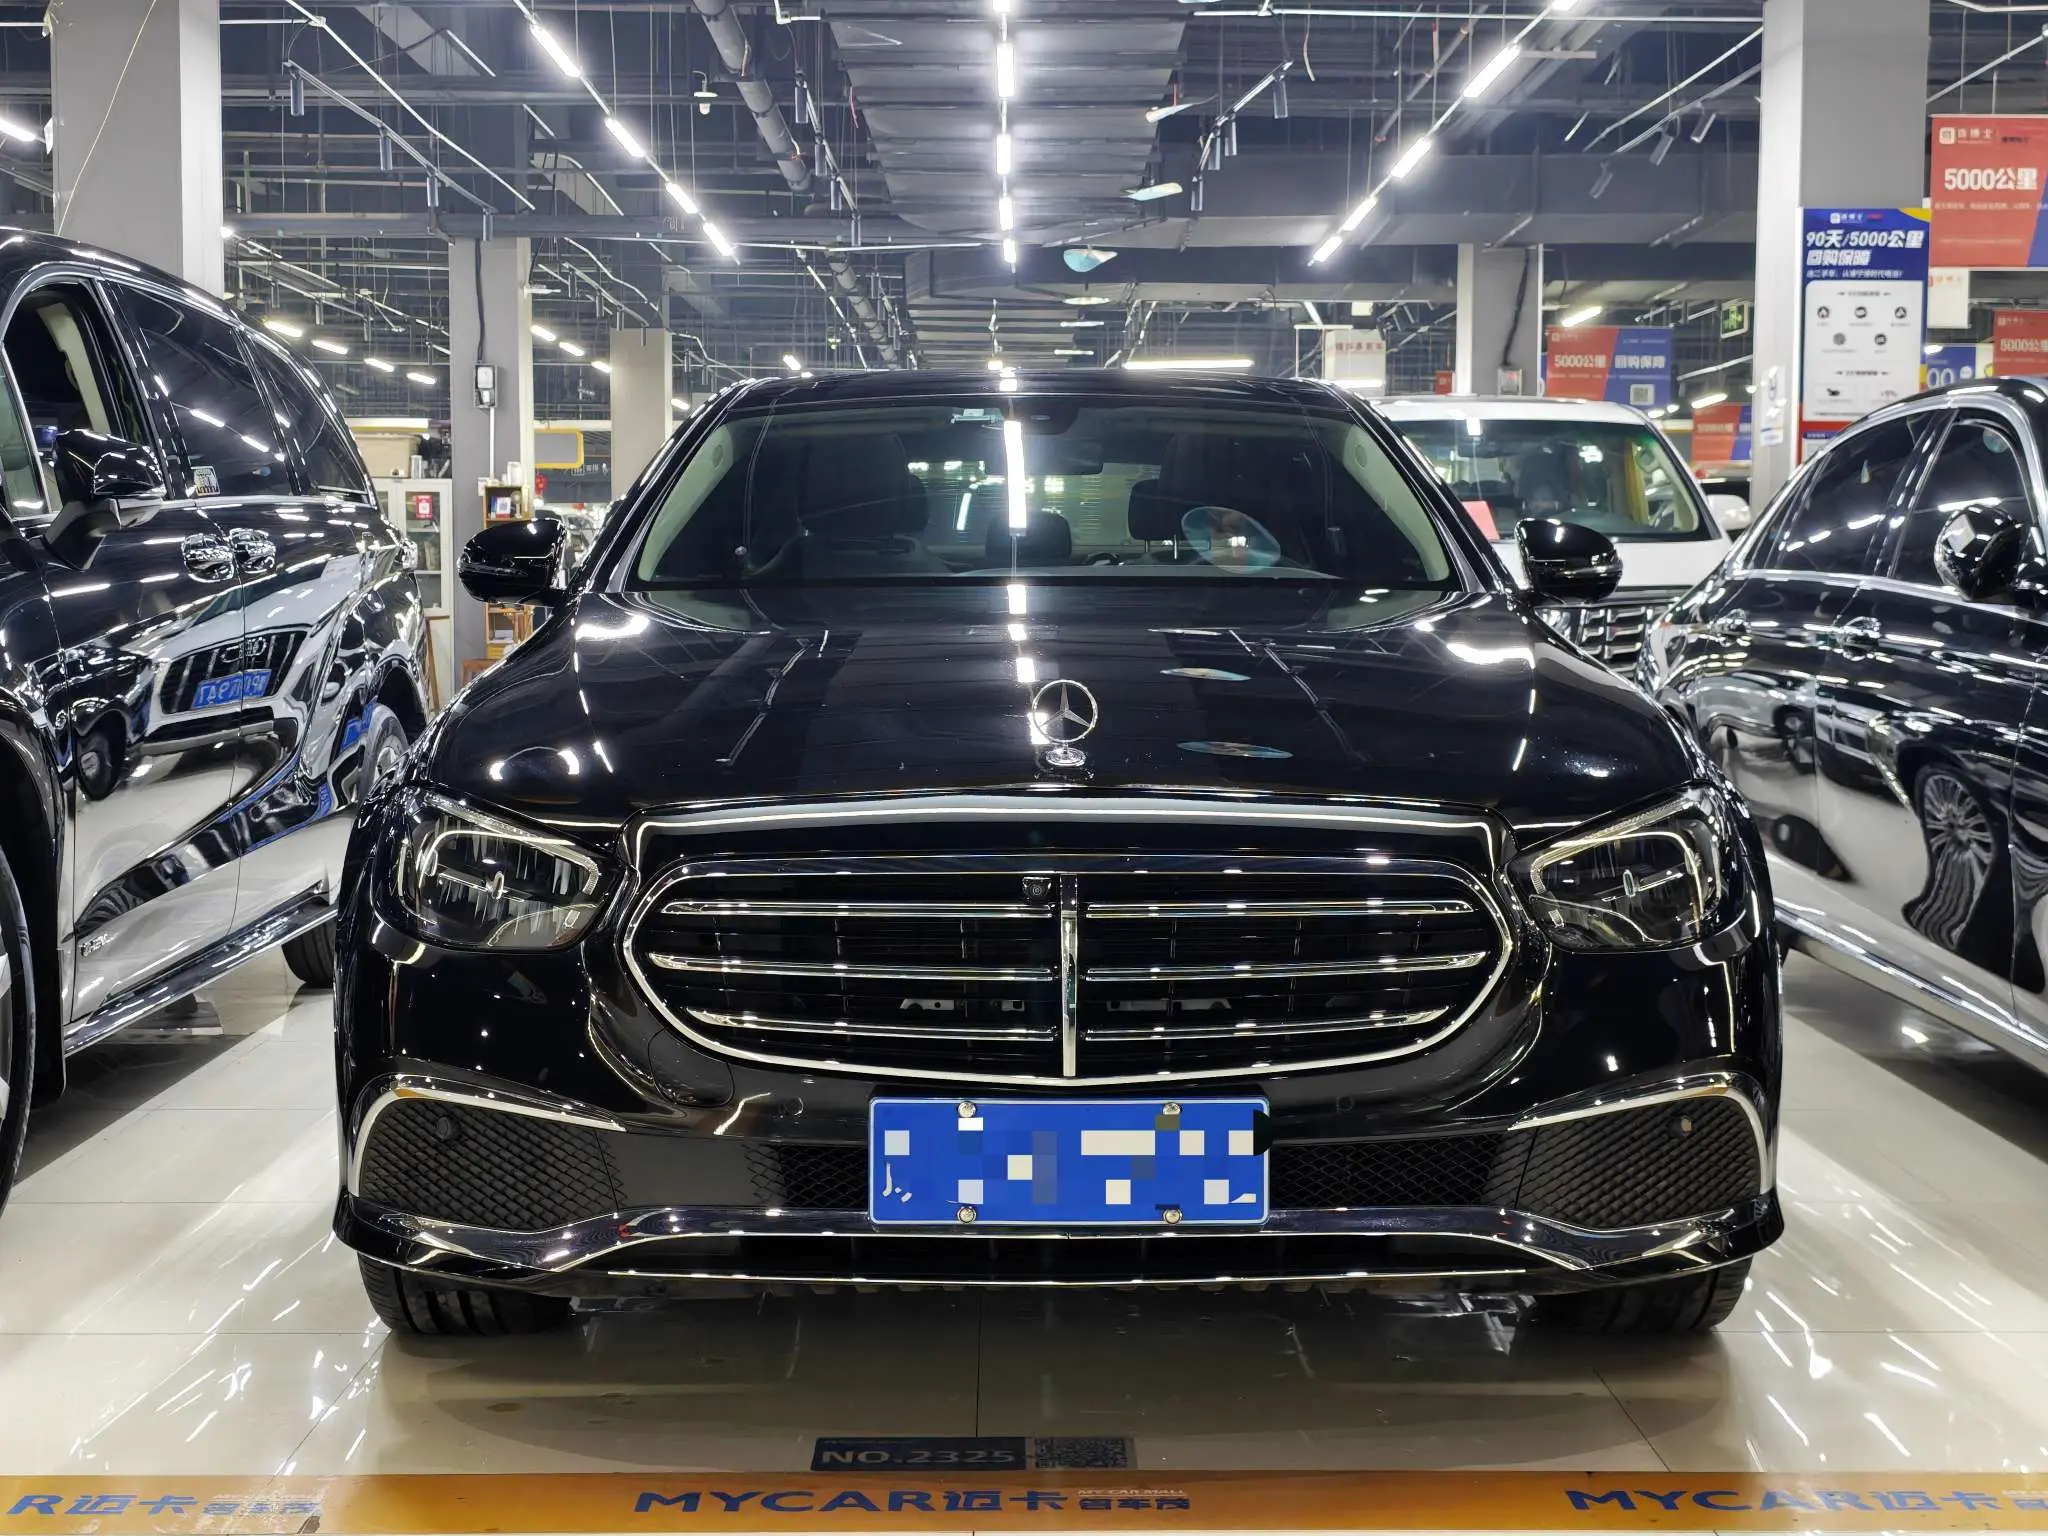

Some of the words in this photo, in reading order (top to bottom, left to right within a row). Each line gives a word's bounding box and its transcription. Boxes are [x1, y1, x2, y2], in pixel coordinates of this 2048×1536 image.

[1943, 166, 2039, 191] 5000公里
[1806, 229, 1925, 248] 90天/5000公里
[820, 1449, 1017, 1464] NO.2325
